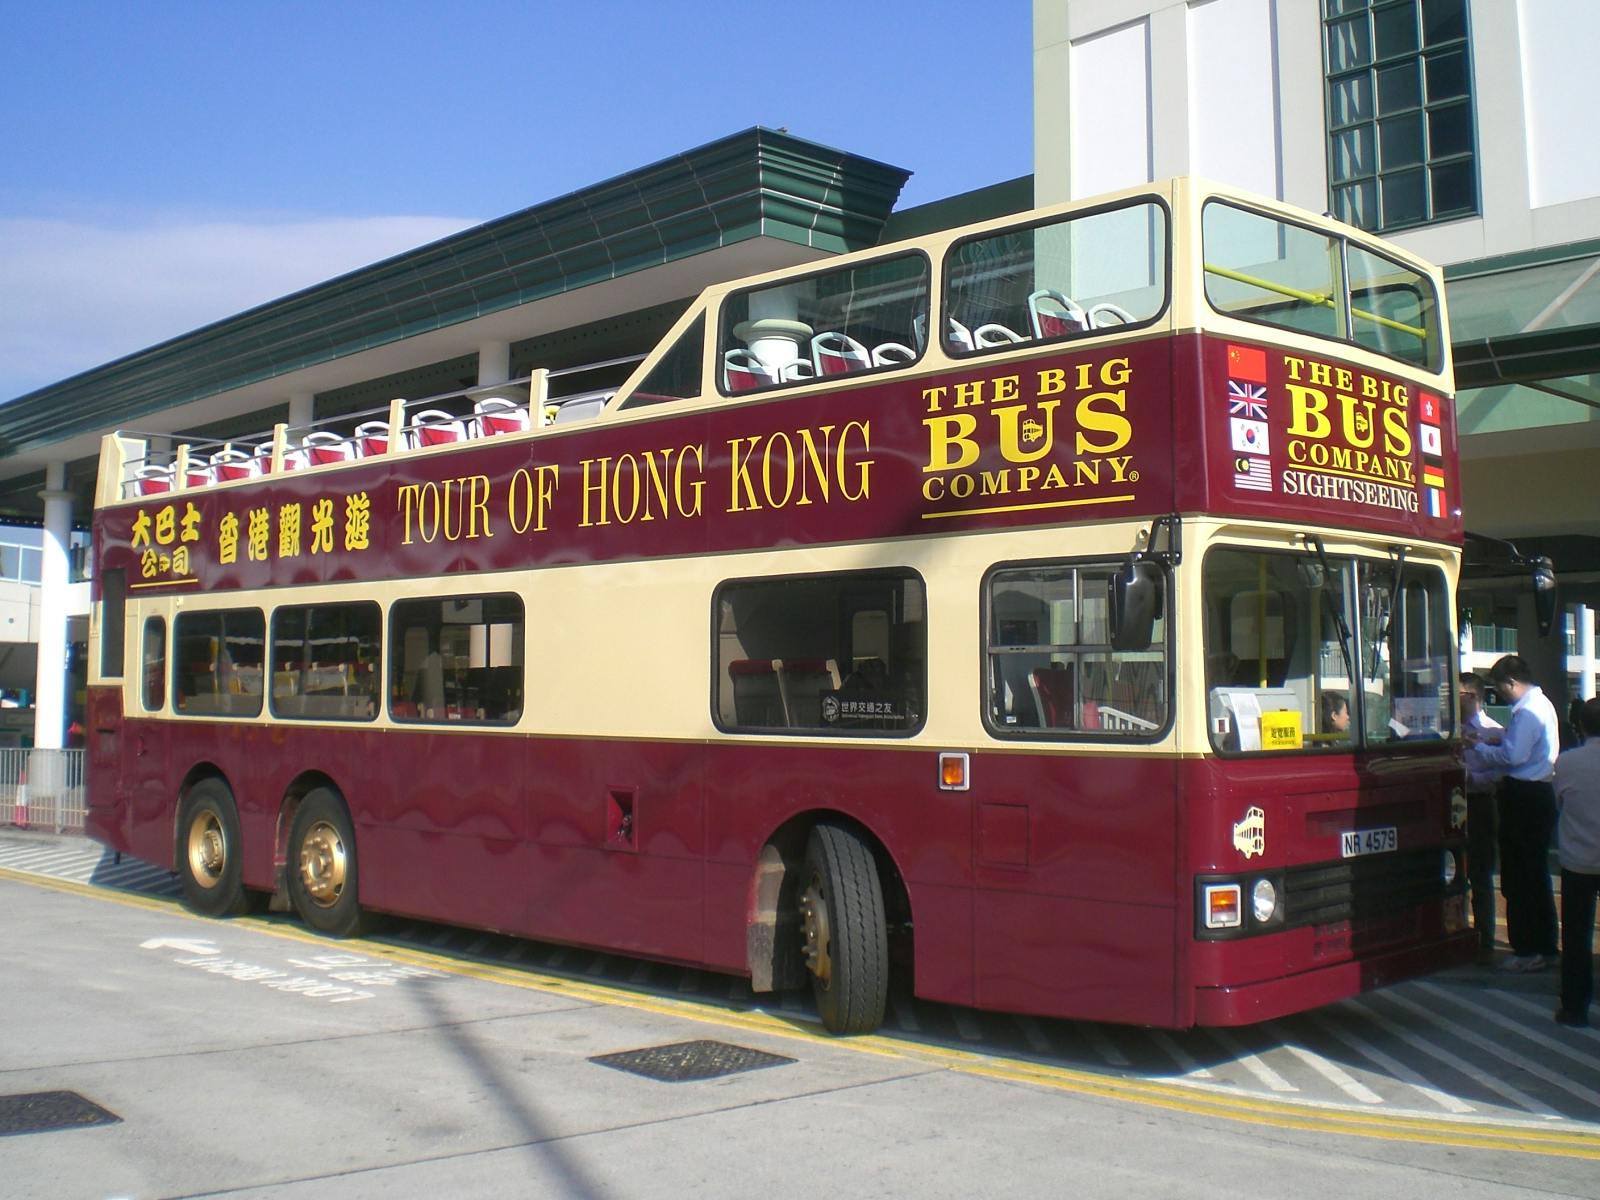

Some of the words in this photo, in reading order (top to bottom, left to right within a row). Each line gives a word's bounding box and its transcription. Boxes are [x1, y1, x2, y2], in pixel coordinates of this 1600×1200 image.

[922, 375, 1020, 412] THE
[1037, 358, 1133, 396] BIG
[1284, 356, 1354, 392] THE
[1361, 374, 1409, 407] BIG
[922, 390, 1133, 473] BUS
[1285, 383, 1412, 457] BUS
[397, 474, 494, 545] TOUR
[507, 464, 560, 535] OF
[577, 443, 707, 528] HONG
[726, 419, 876, 514] KONG
[1282, 470, 1419, 514] SIGHTSEEING
[131, 502, 200, 549] 大巴士
[141, 546, 189, 578] 公司
[1345, 834, 1361, 855] NR
[1366, 829, 1395, 852] 4579
